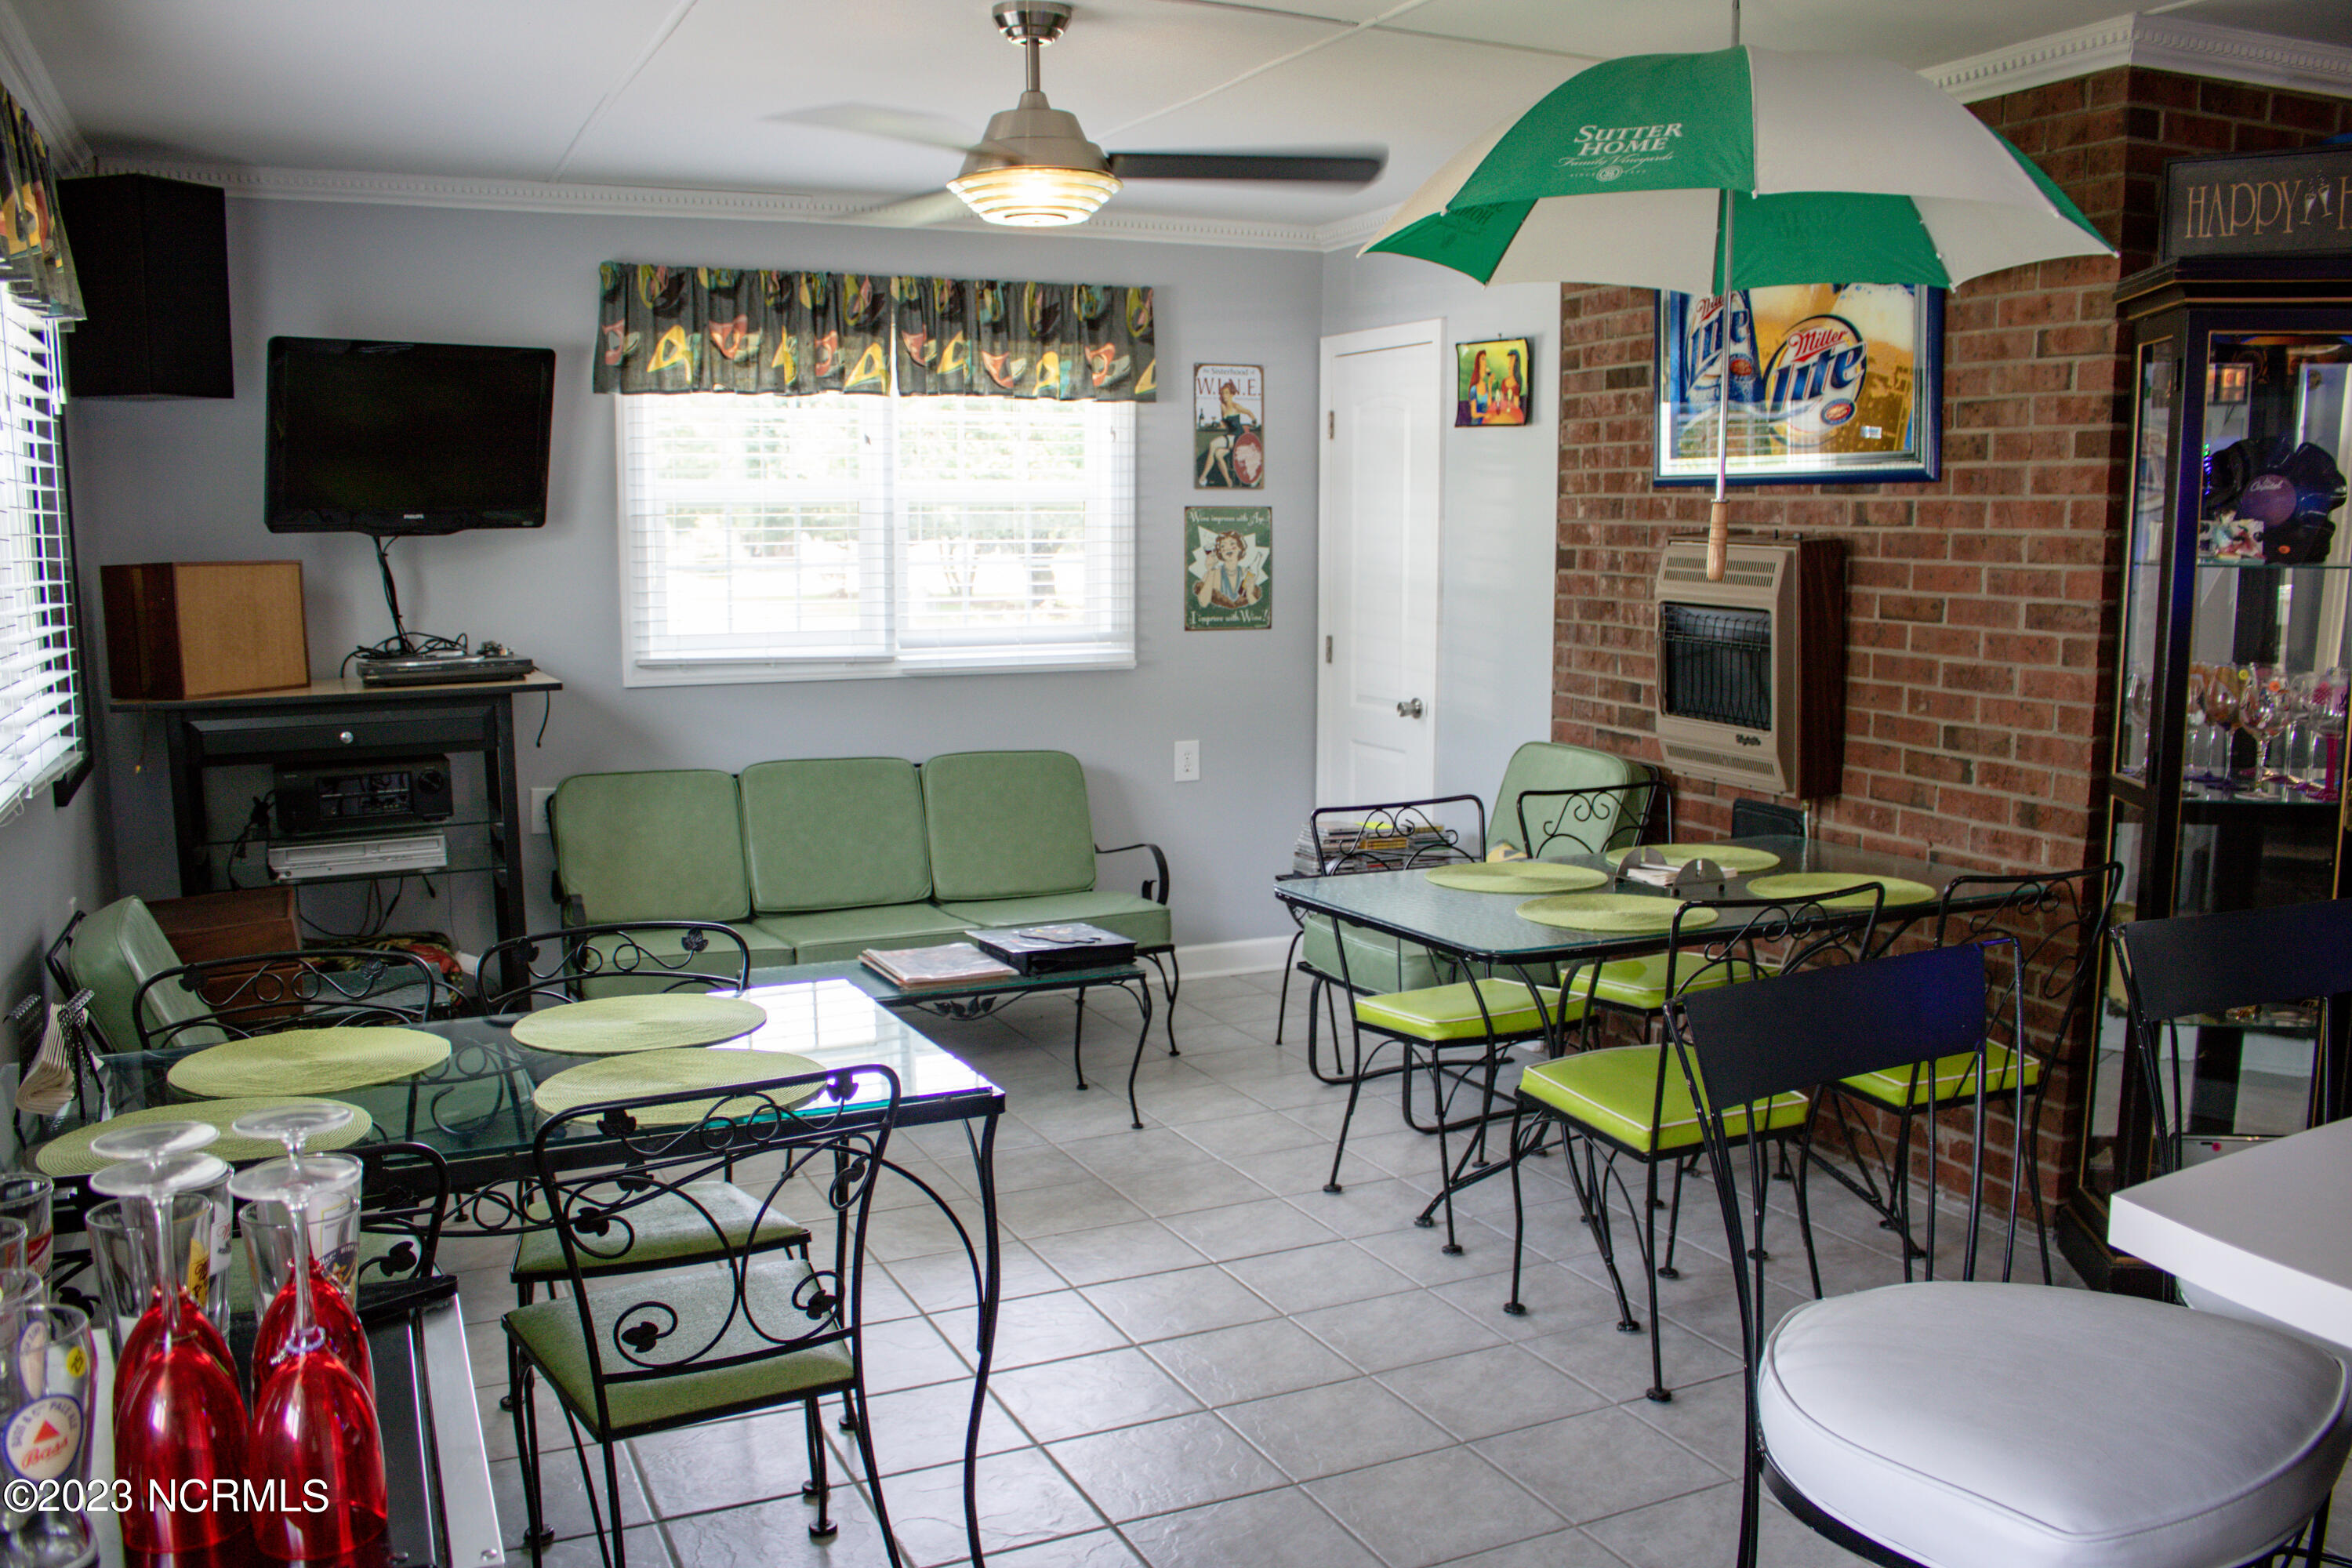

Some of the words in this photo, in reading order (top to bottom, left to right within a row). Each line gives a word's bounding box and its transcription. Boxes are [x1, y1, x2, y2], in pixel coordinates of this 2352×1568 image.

[1573, 123, 1683, 143] SUTTER
[1577, 138, 1668, 156] HOME
[2184, 180, 2303, 238] HAPPY
[1788, 328, 1849, 358] Miller
[1769, 345, 1864, 412] Lite
[21, 1436, 68, 1470] Bass
